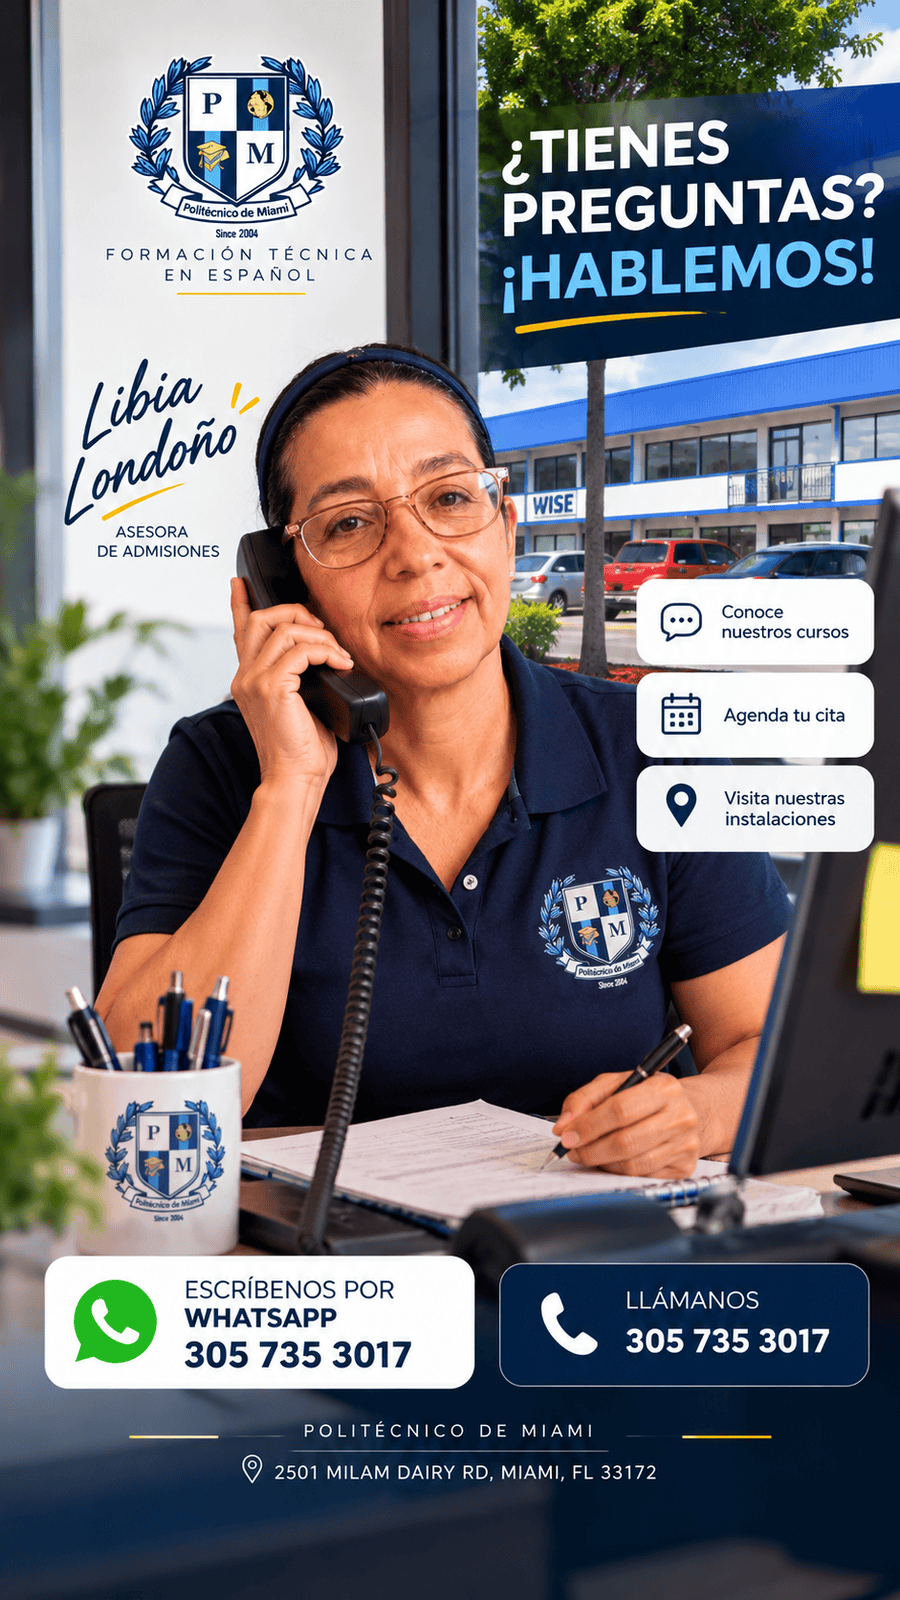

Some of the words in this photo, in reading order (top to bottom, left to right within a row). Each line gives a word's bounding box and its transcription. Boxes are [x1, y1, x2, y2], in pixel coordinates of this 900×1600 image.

[533, 493, 574, 515] WISE
[574, 895, 588, 912] P
[608, 920, 627, 938] M
[147, 1125, 160, 1140] P
[175, 1157, 193, 1173] M
